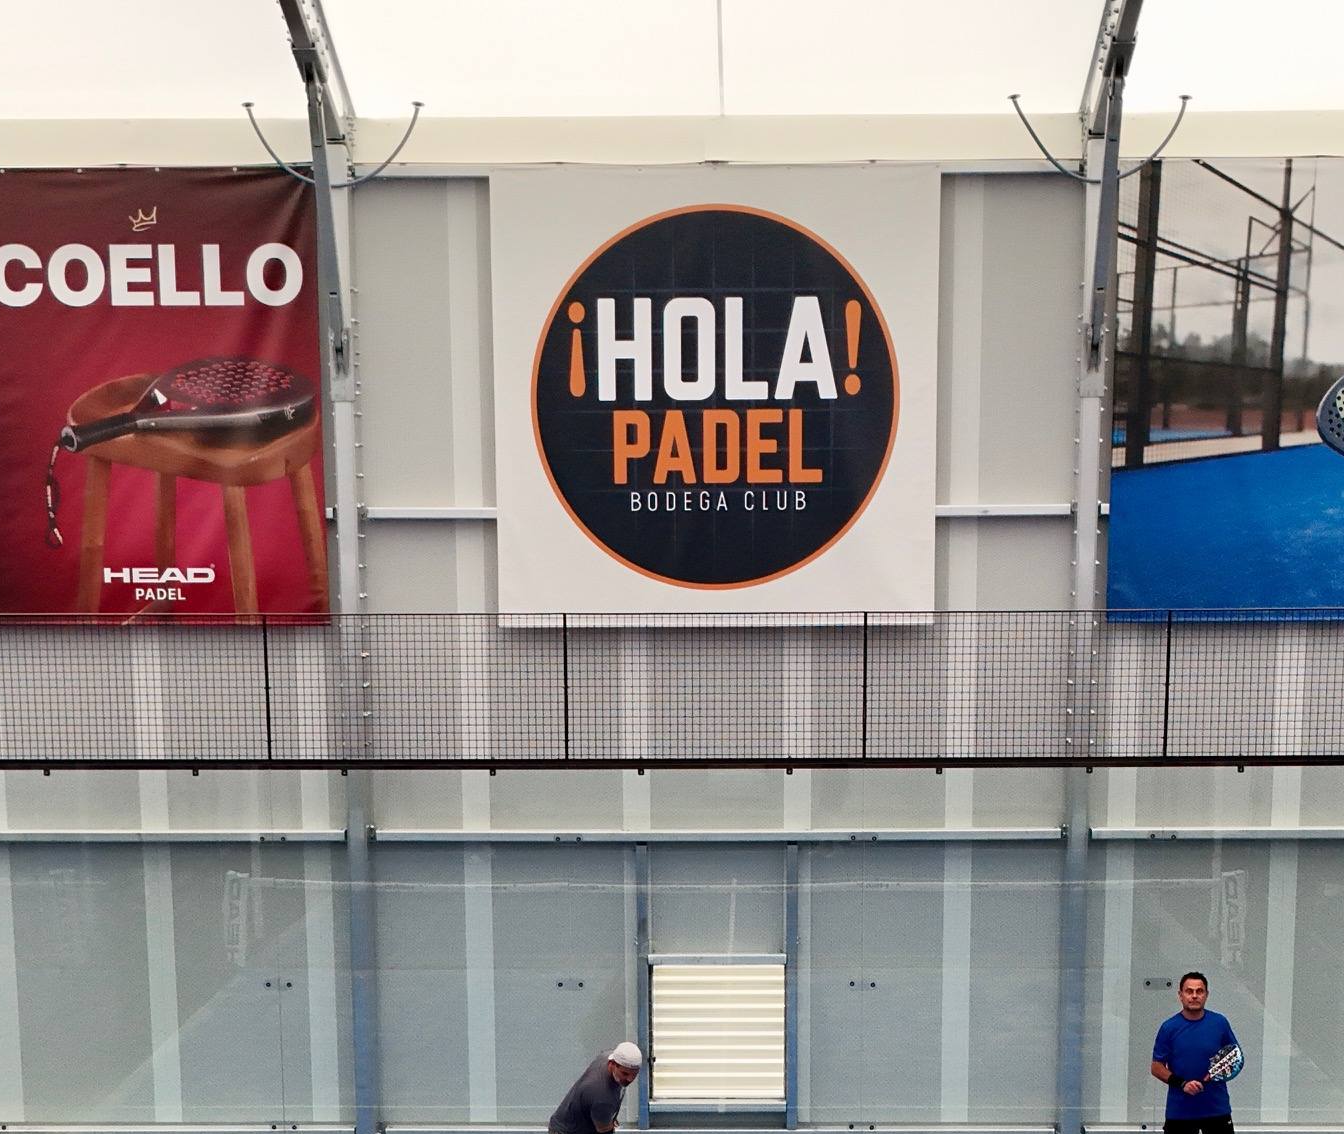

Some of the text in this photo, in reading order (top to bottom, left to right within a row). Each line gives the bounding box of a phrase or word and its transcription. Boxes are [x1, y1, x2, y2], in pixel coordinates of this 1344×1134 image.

[568, 296, 862, 401] ¡HOLA!
[613, 408, 823, 485] PADEL
[630, 490, 807, 512] BODEGA CLUB
[103, 567, 216, 584] HEAD
[135, 588, 186, 600] PADEL
